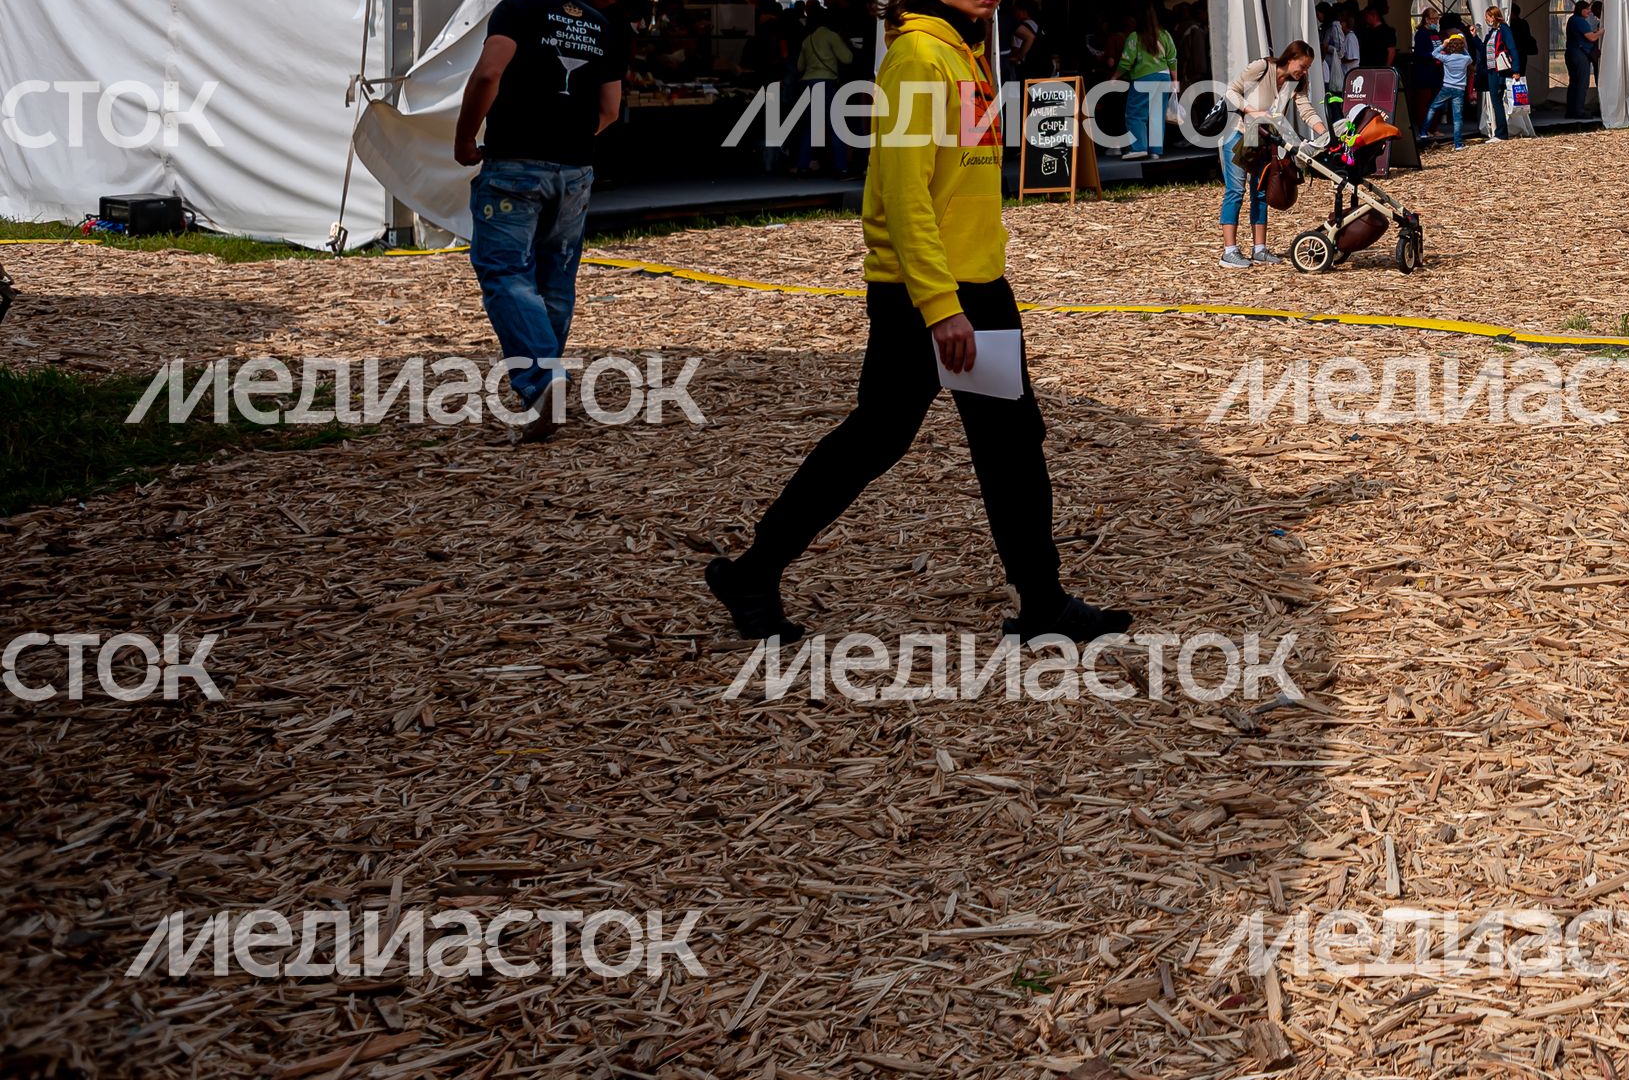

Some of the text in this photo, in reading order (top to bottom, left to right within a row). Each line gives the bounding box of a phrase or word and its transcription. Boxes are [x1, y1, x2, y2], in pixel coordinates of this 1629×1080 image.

[548, 13, 601, 32] KEEP CALM
[566, 25, 587, 34] AND
[556, 30, 596, 45] SHAKEN
[564, 41, 603, 56] STIRRED
[1038, 131, 1073, 147] Европе
